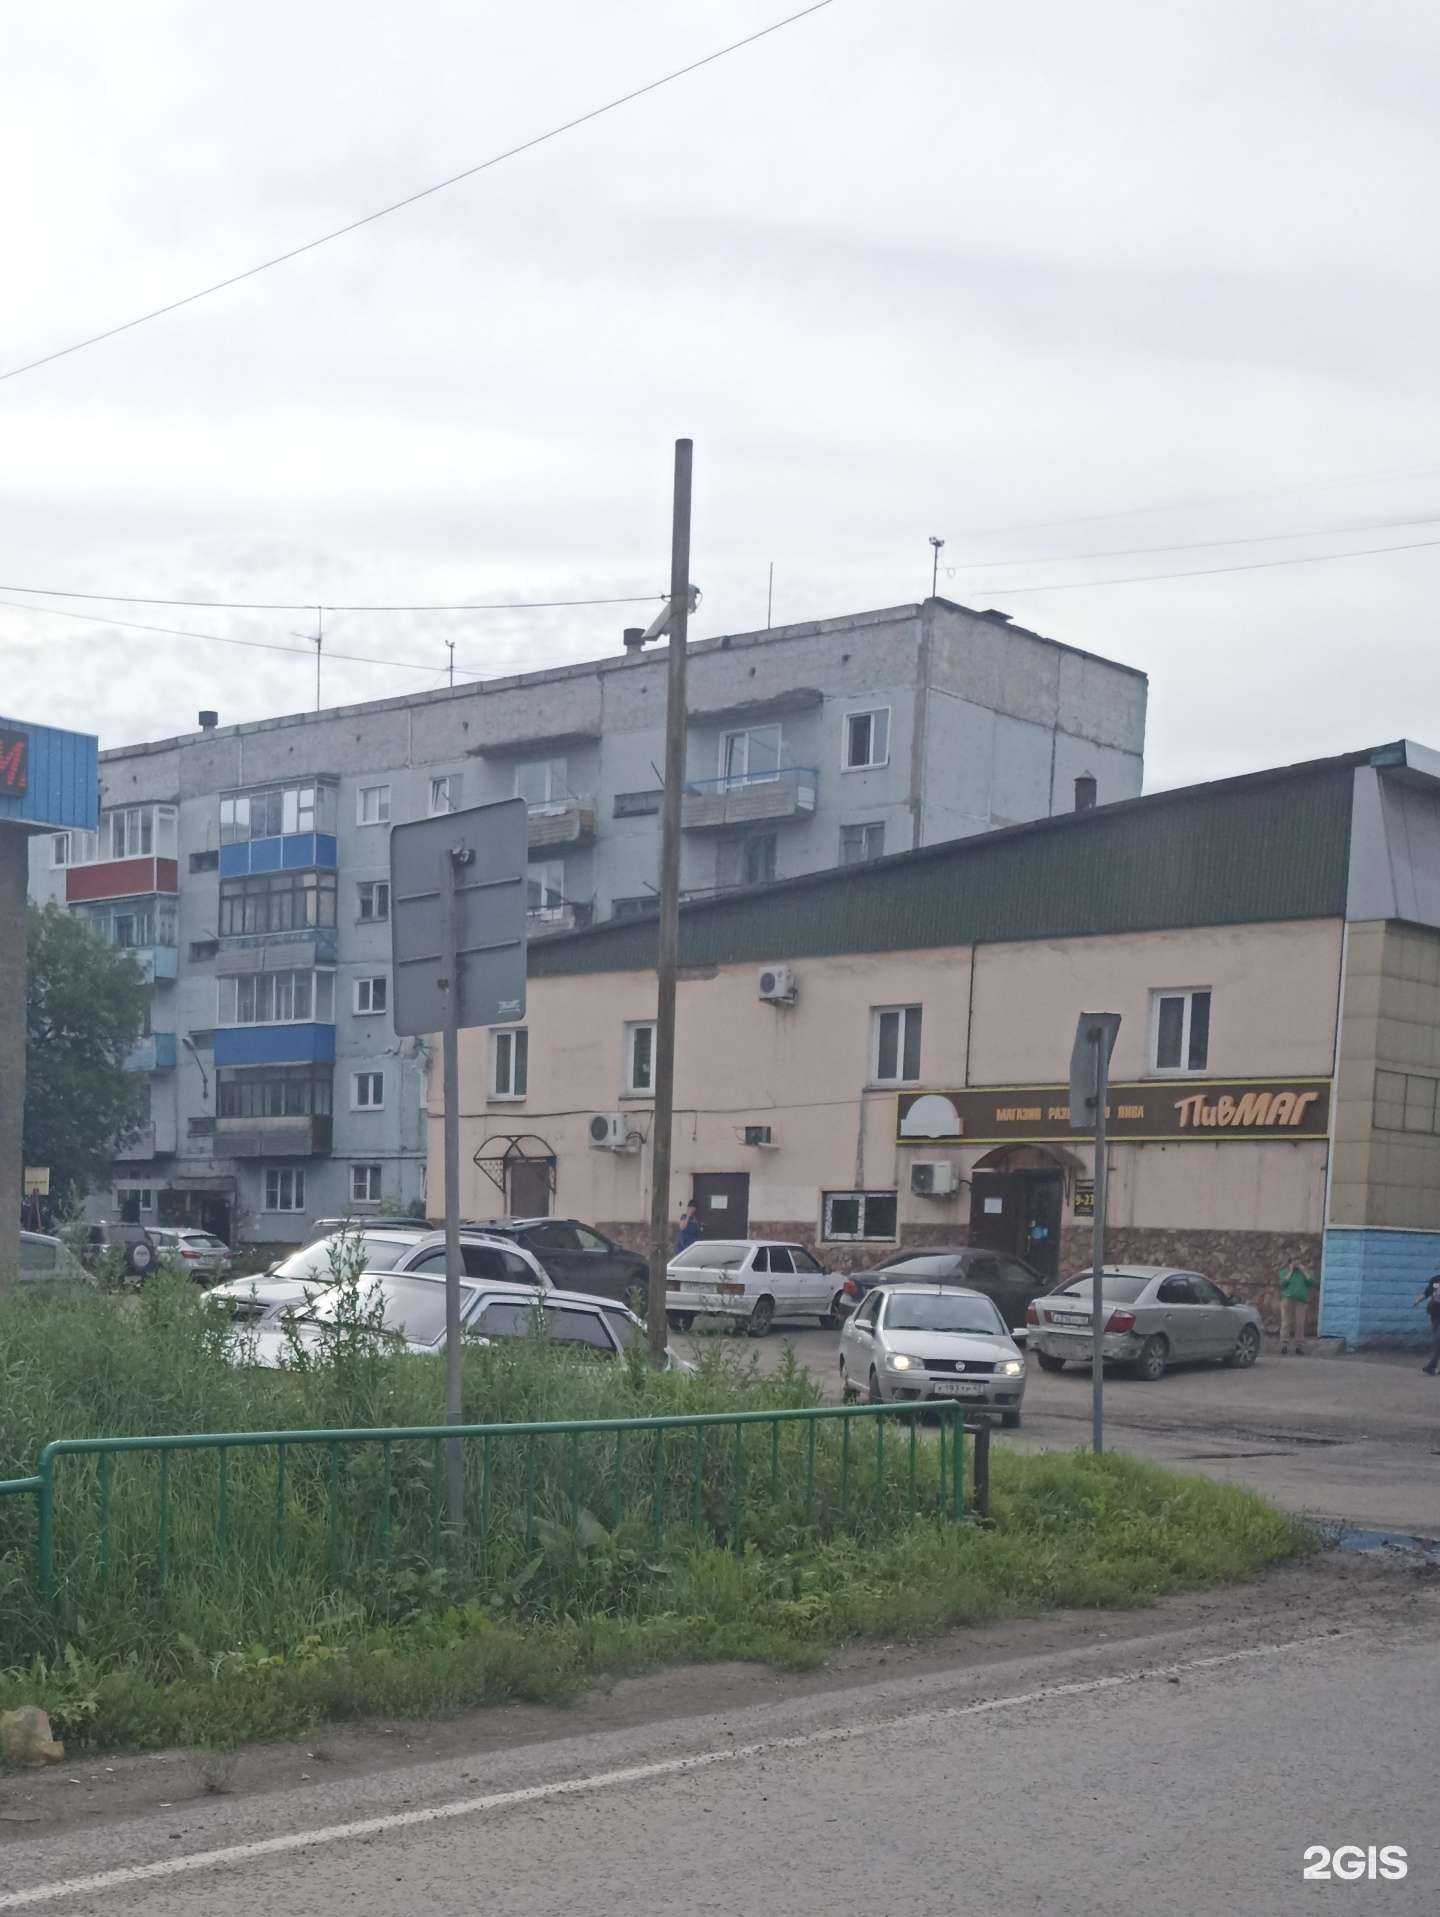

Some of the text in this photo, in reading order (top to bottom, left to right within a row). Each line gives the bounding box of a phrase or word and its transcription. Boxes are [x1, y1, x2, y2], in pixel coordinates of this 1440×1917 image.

[996, 1108, 1042, 1120] МАГАЗИН
[1118, 1105, 1144, 1119] ПИВА
[1174, 1092, 1320, 1126] ПивМАГ
